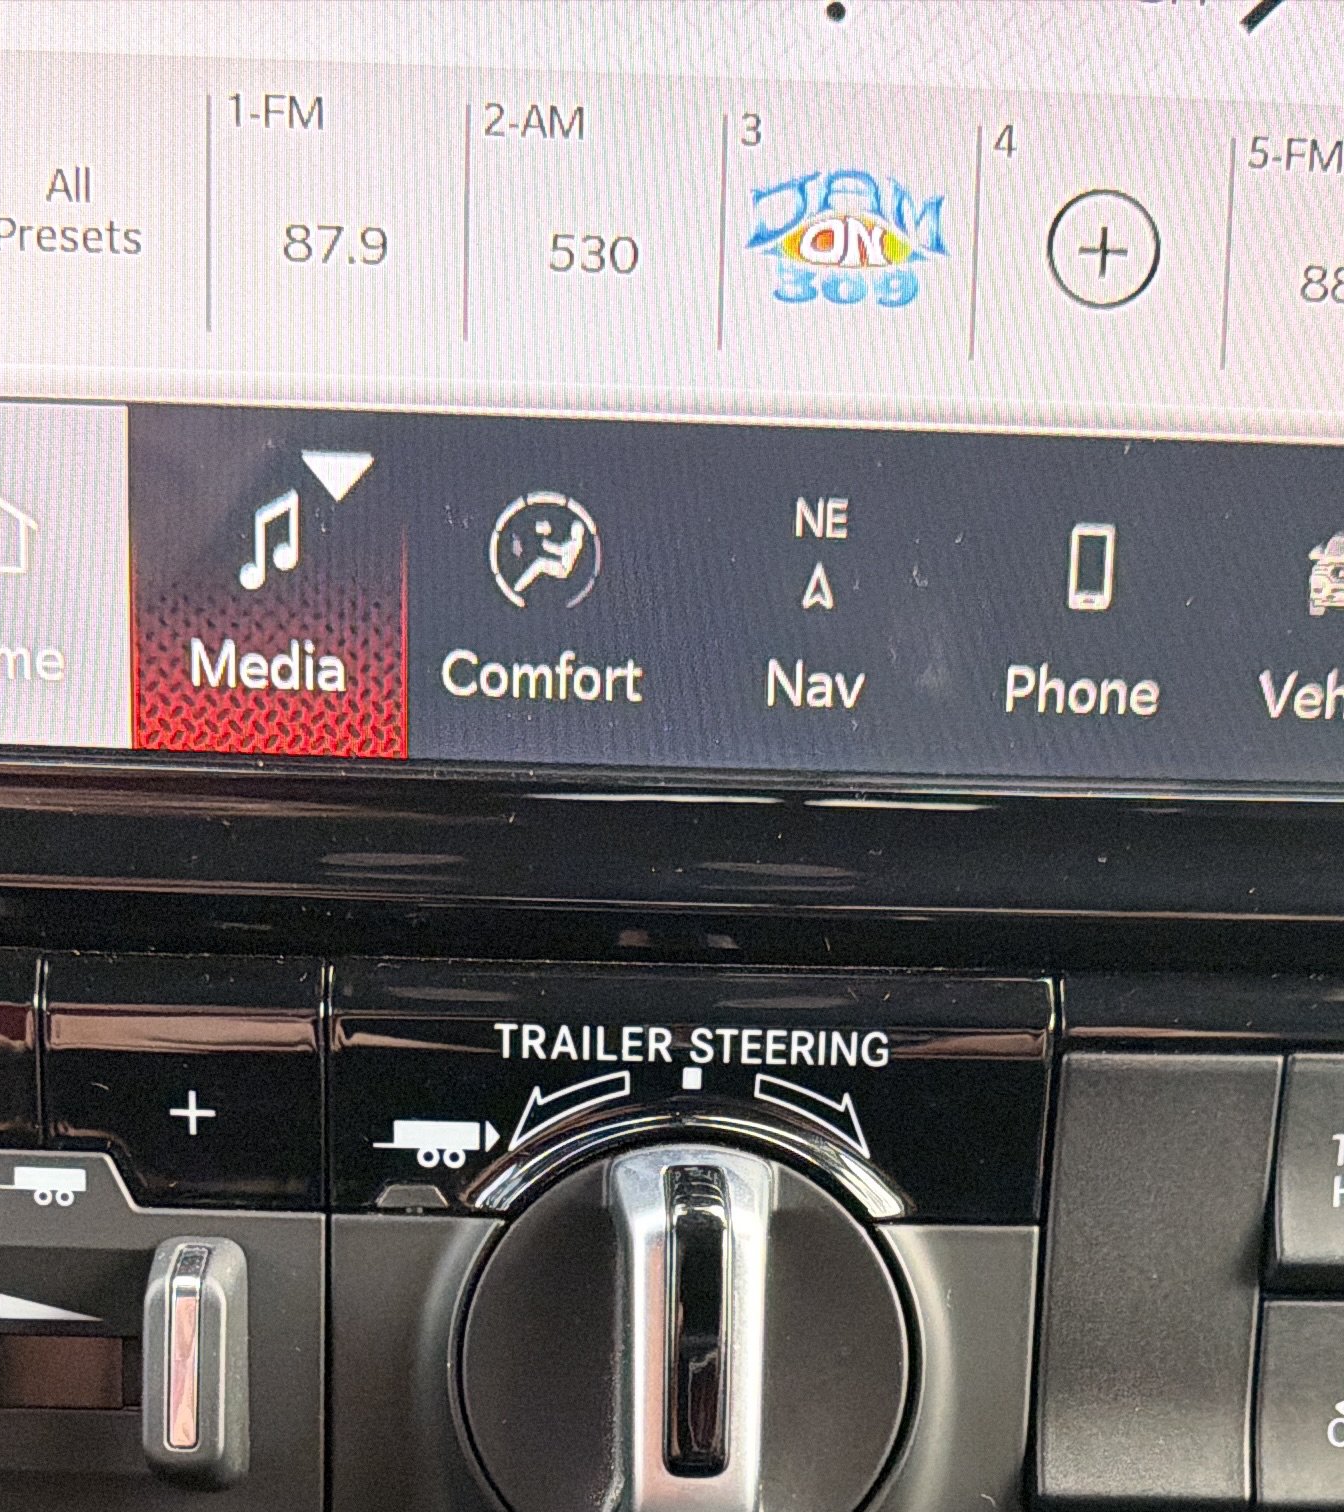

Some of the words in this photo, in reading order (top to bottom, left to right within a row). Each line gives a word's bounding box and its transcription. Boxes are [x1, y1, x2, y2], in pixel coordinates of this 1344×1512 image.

[229, 94, 325, 132] 1-FM
[485, 104, 585, 142] 2-AM
[741, 112, 762, 146] 3
[994, 124, 1017, 159] 4
[1248, 136, 1344, 175] 5-FM
[47, 167, 91, 205] All
[746, 169, 949, 256] JAM
[284, 224, 389, 267] 87.9
[549, 234, 640, 276] 530
[799, 214, 892, 269] ON
[795, 498, 849, 541] NE
[191, 640, 347, 694] Media
[442, 650, 642, 704] Comfort
[767, 660, 866, 711] Nav
[1006, 664, 1160, 717] Phone
[495, 1022, 673, 1064] TRAILER
[688, 1026, 890, 1070] STEERING
